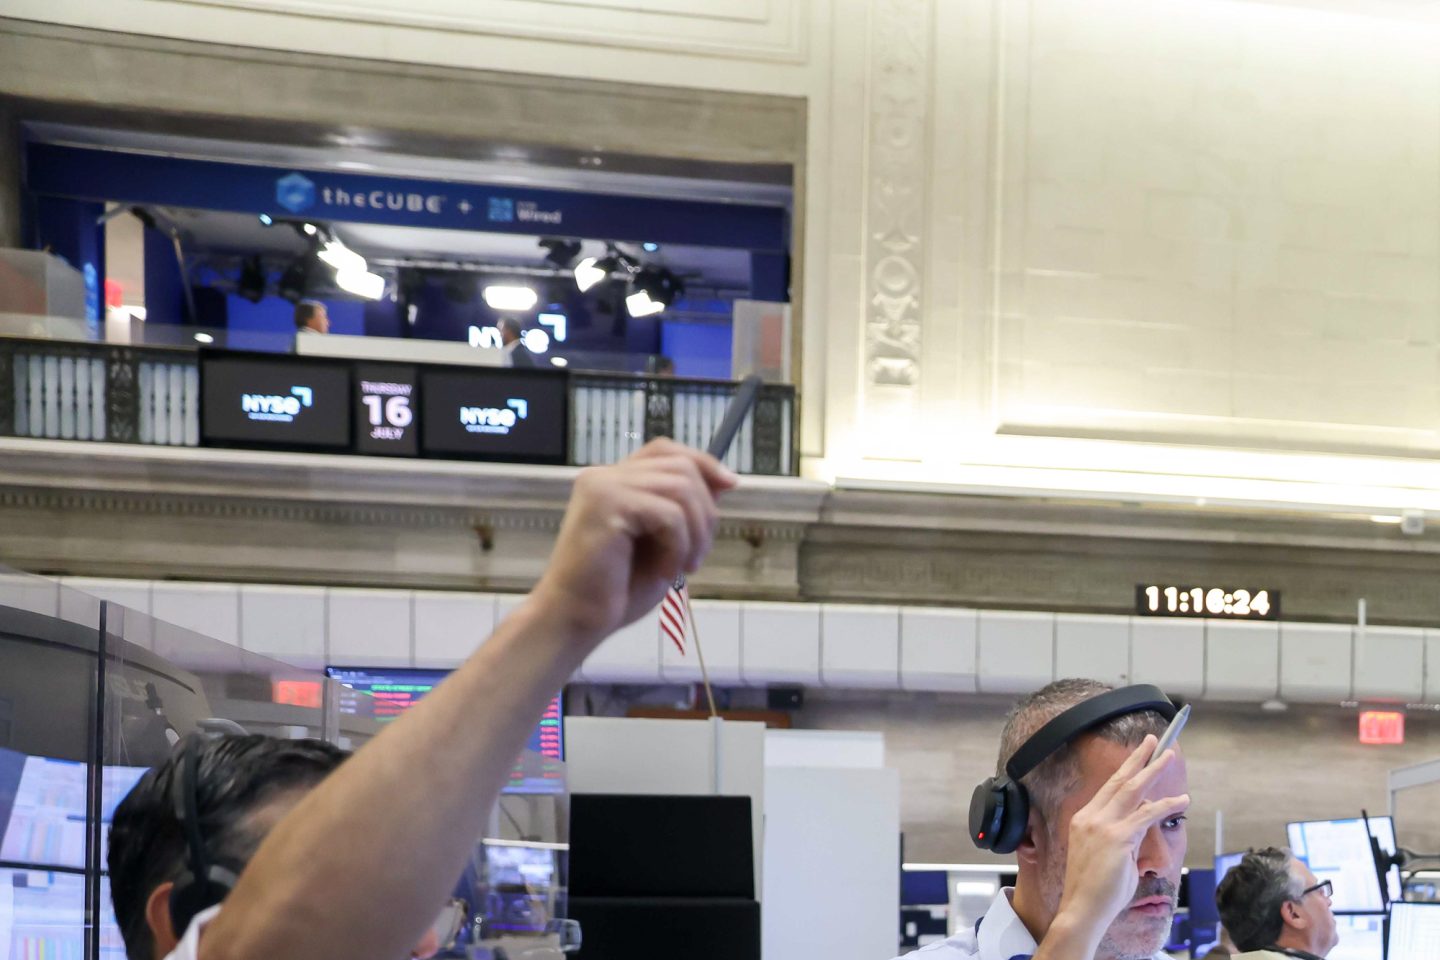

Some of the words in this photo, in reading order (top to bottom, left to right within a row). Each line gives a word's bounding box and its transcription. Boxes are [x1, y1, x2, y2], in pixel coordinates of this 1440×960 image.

[360, 380, 412, 396] THURSDAY
[362, 394, 412, 427] 16
[370, 426, 404, 440] JULY
[1145, 585, 1271, 616] 11:16:24
